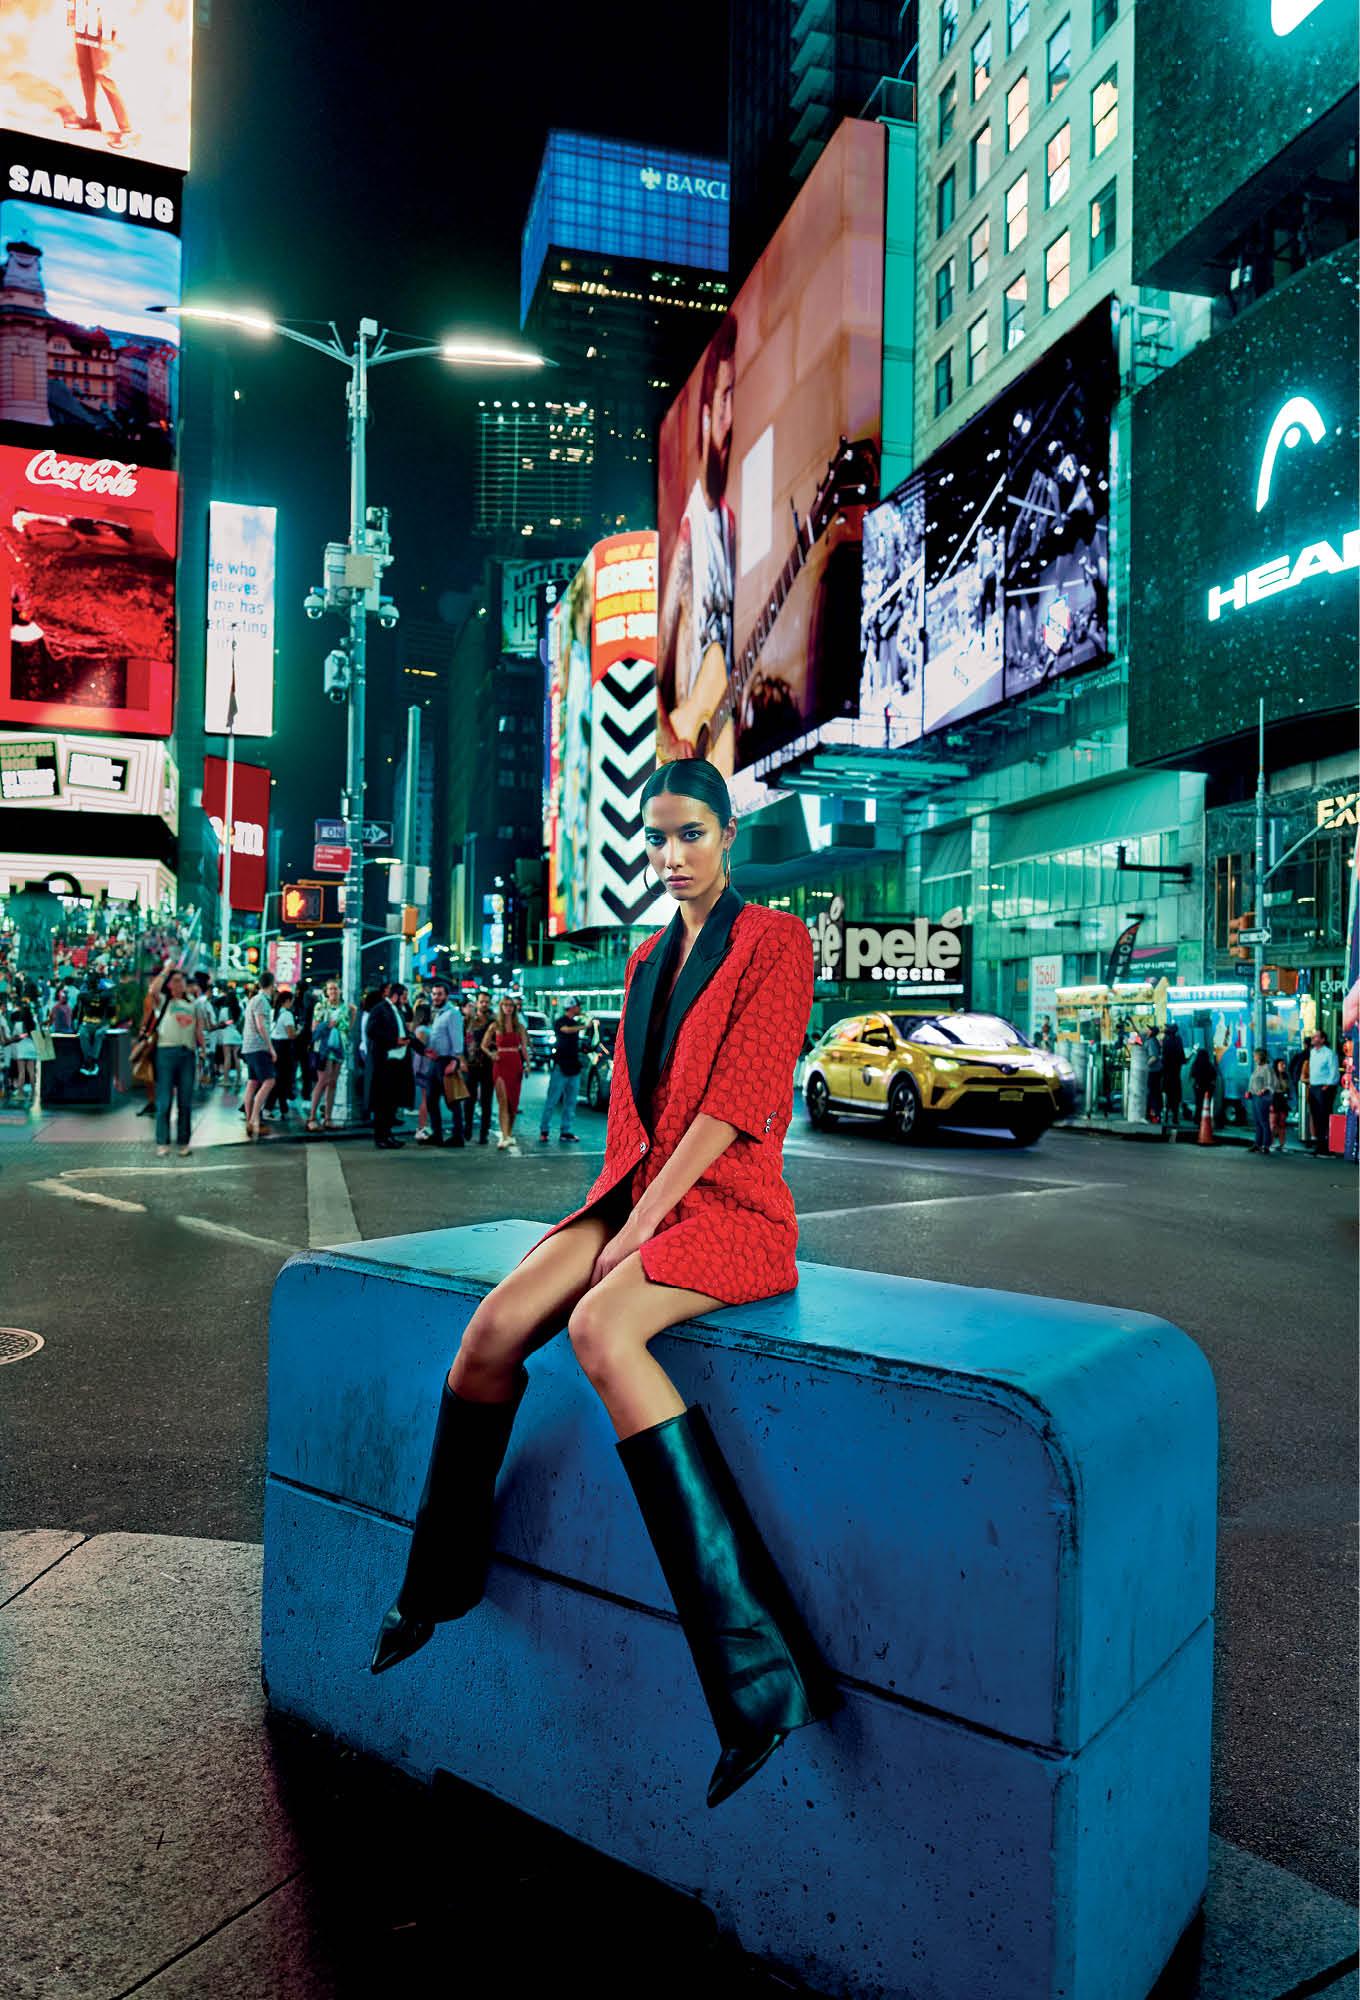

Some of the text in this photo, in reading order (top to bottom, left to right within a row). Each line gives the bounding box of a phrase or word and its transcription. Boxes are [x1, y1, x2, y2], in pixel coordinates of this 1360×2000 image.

[8, 165, 174, 223] SAMSUNG
[666, 173, 728, 201] BARCL
[25, 450, 138, 498] Coca-Cola
[228, 560, 256, 577] who
[240, 600, 264, 615] has
[1317, 792, 1359, 829] EX
[846, 906, 962, 979] pelé
[871, 966, 945, 981] SOCCER
